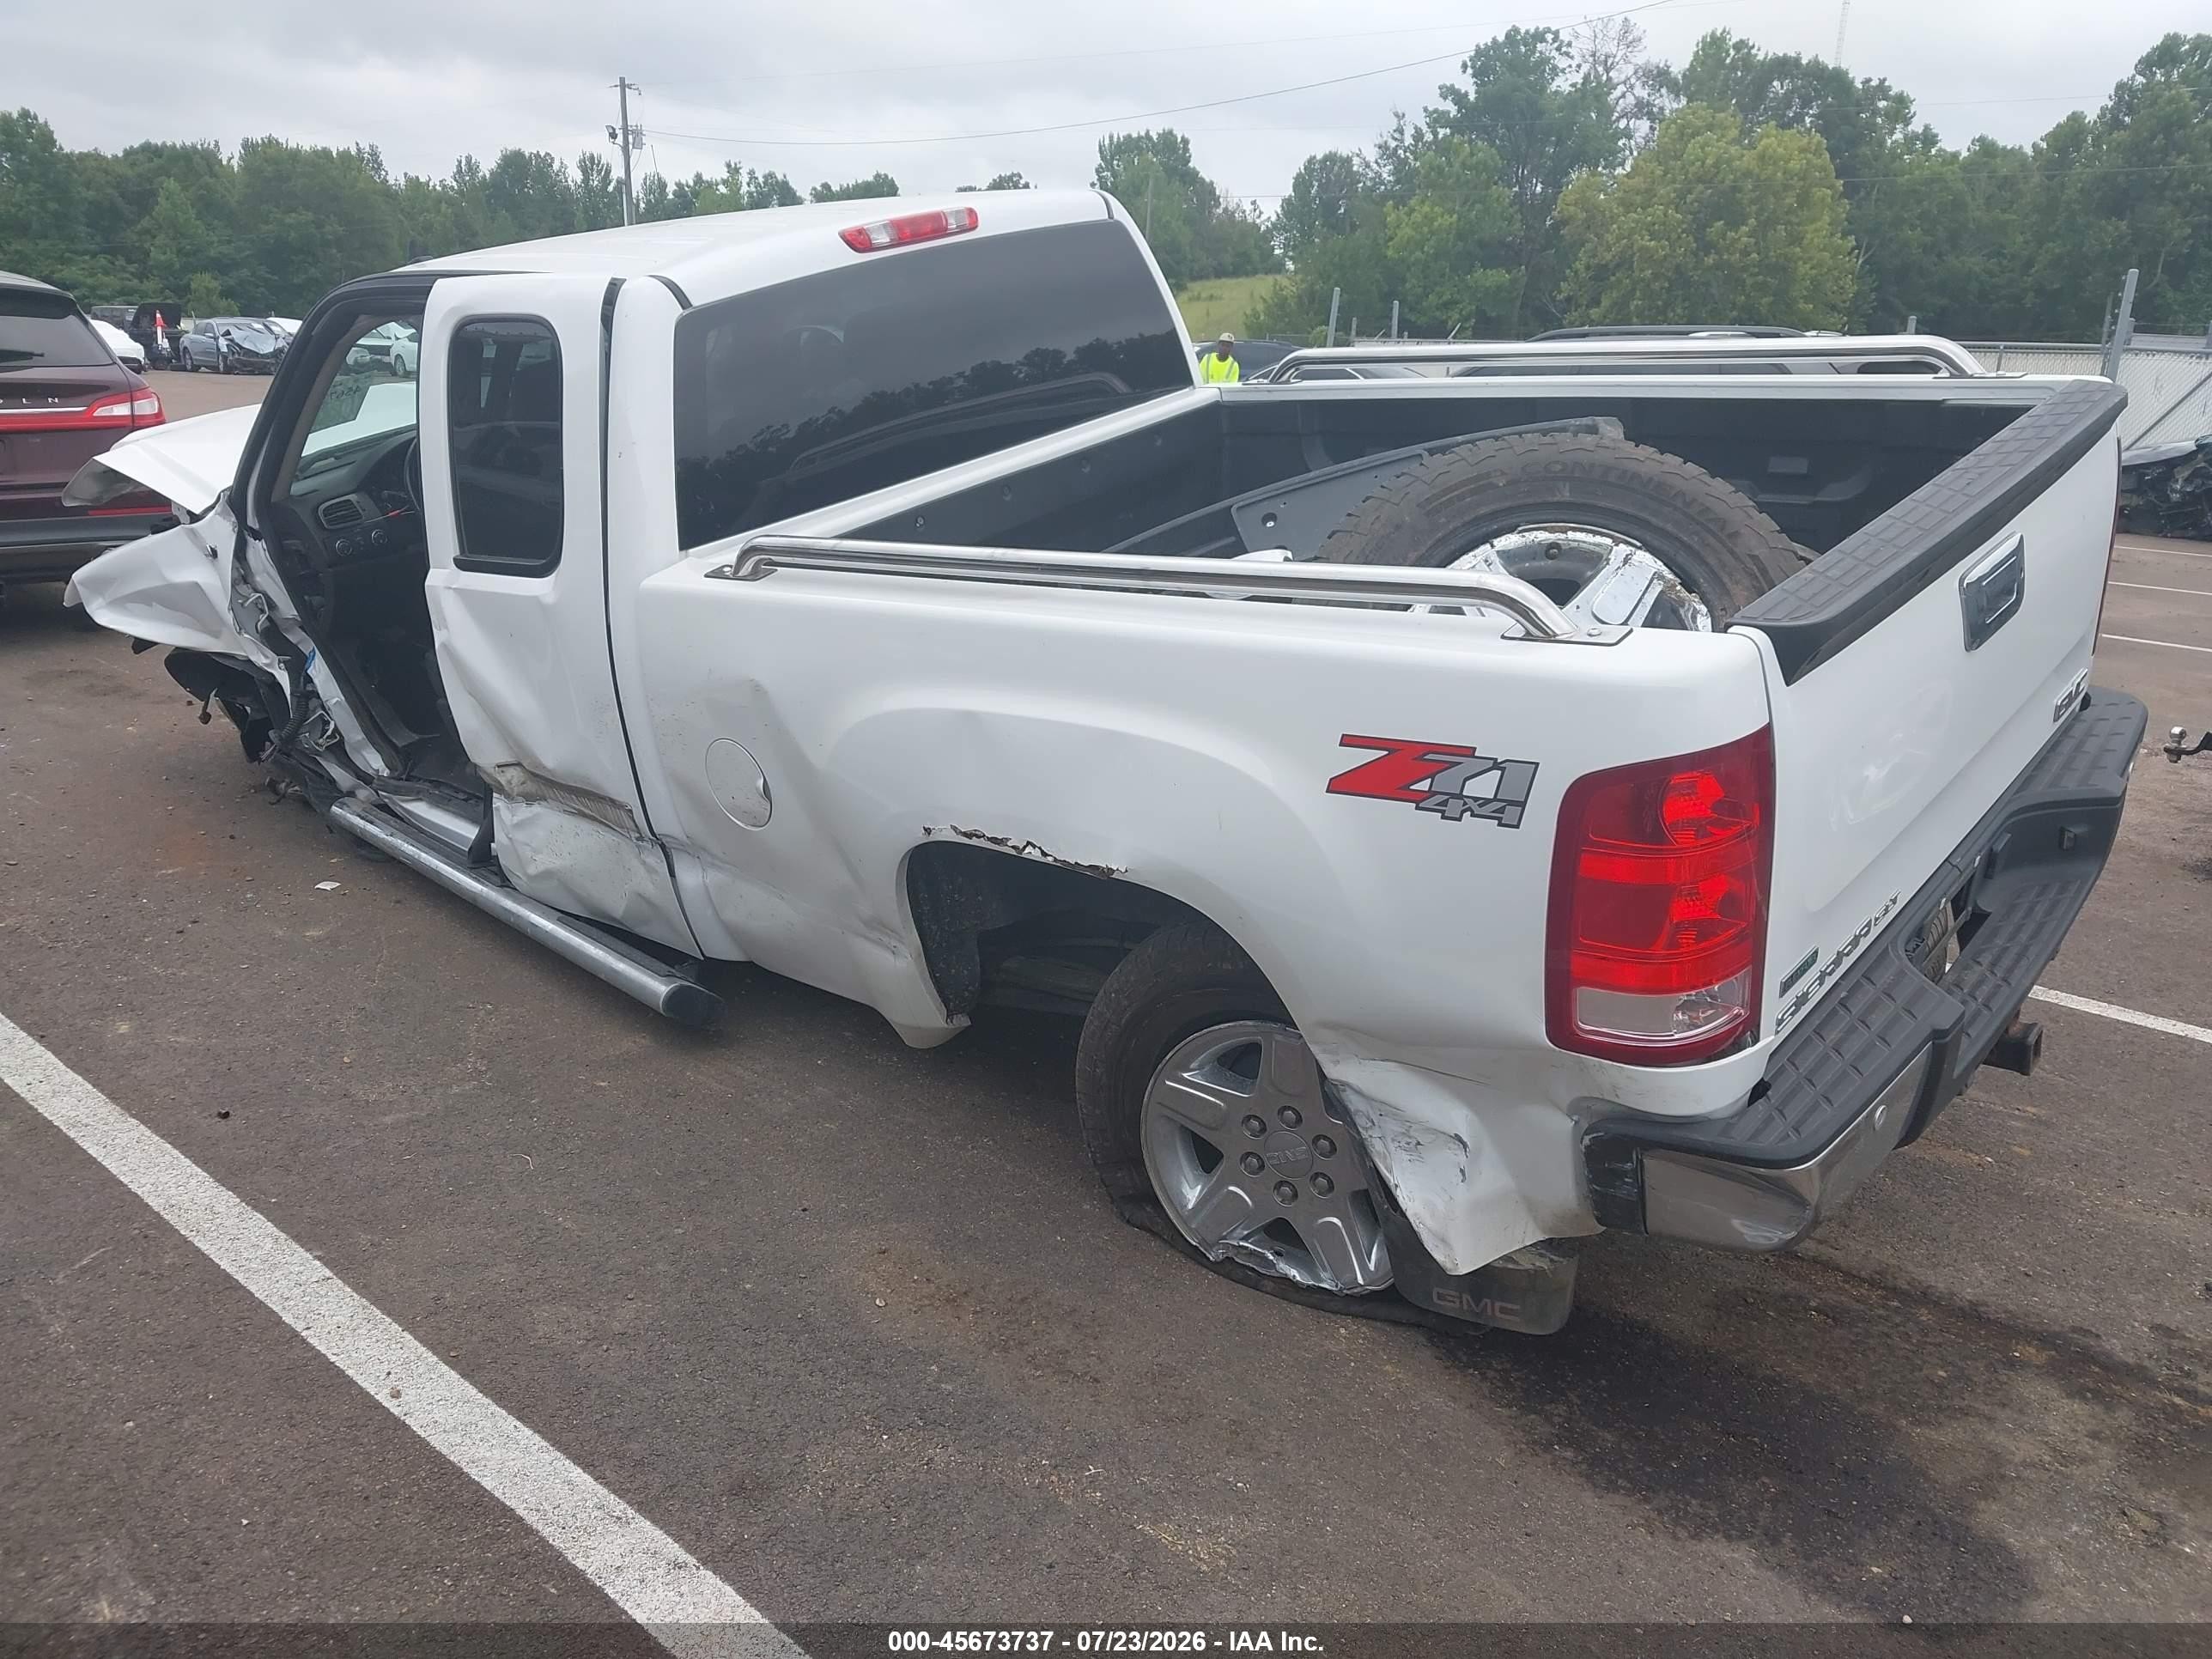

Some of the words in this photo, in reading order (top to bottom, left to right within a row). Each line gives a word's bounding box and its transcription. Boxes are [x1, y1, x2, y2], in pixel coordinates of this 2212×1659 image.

[1325, 733, 1540, 805] Z71
[1774, 916, 1873, 1036] SIERRA
[1432, 1287, 1521, 1322] GMC
